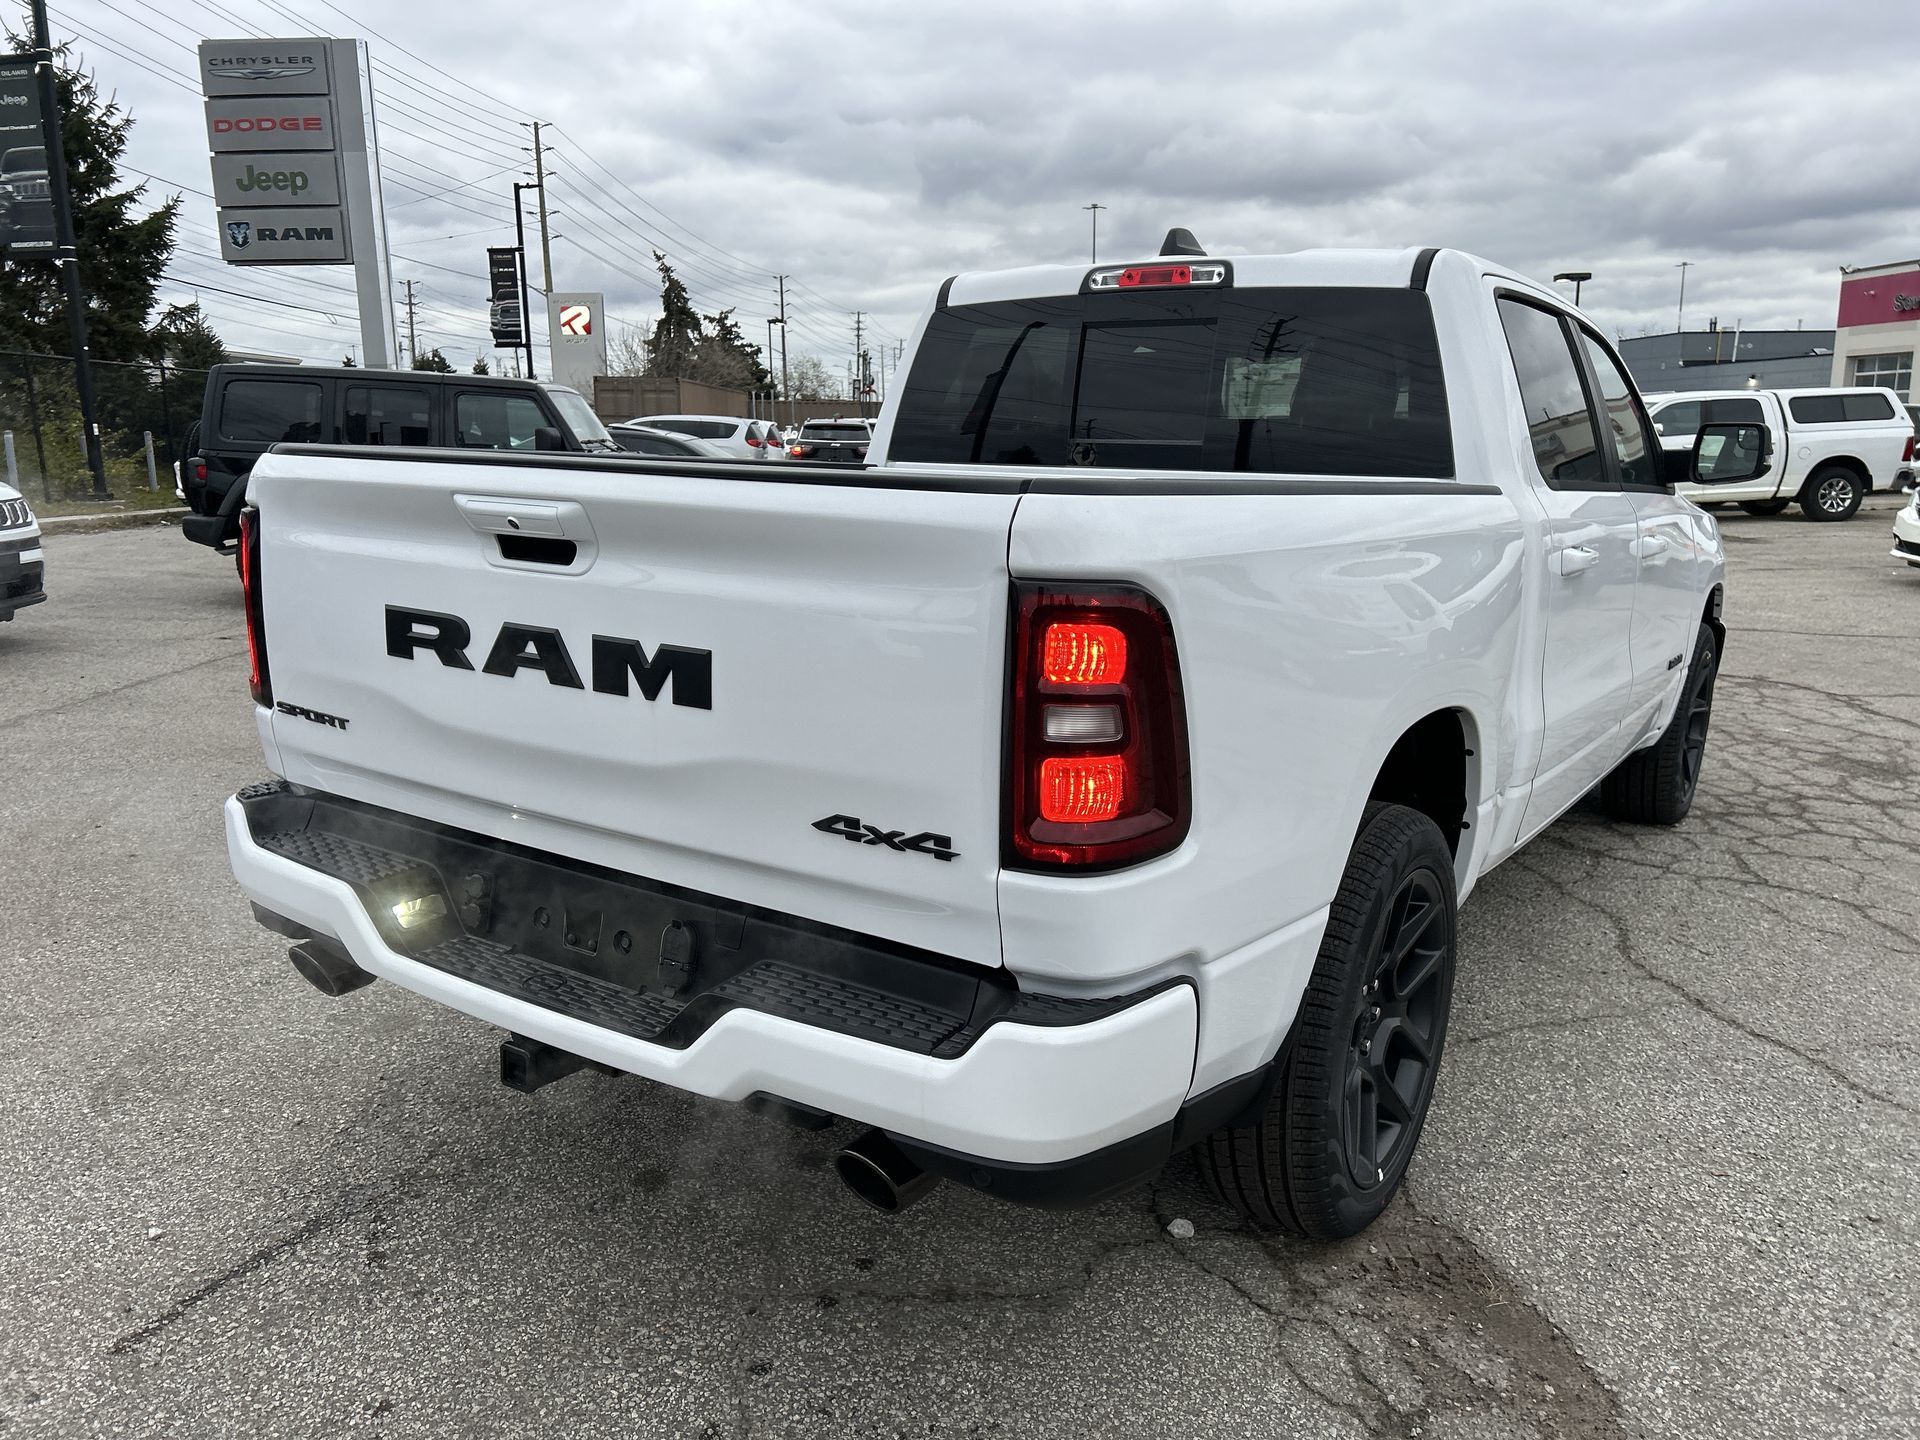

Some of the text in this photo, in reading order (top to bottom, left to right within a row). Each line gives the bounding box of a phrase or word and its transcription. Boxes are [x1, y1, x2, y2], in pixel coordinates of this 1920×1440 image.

[207, 56, 314, 66] CHRYSLER
[0, 94, 28, 106] Jeep
[213, 117, 323, 133] DODGE
[235, 164, 309, 196] Jeep
[256, 227, 334, 241] RAM
[385, 603, 713, 711] RAM
[276, 700, 350, 731] SPORT
